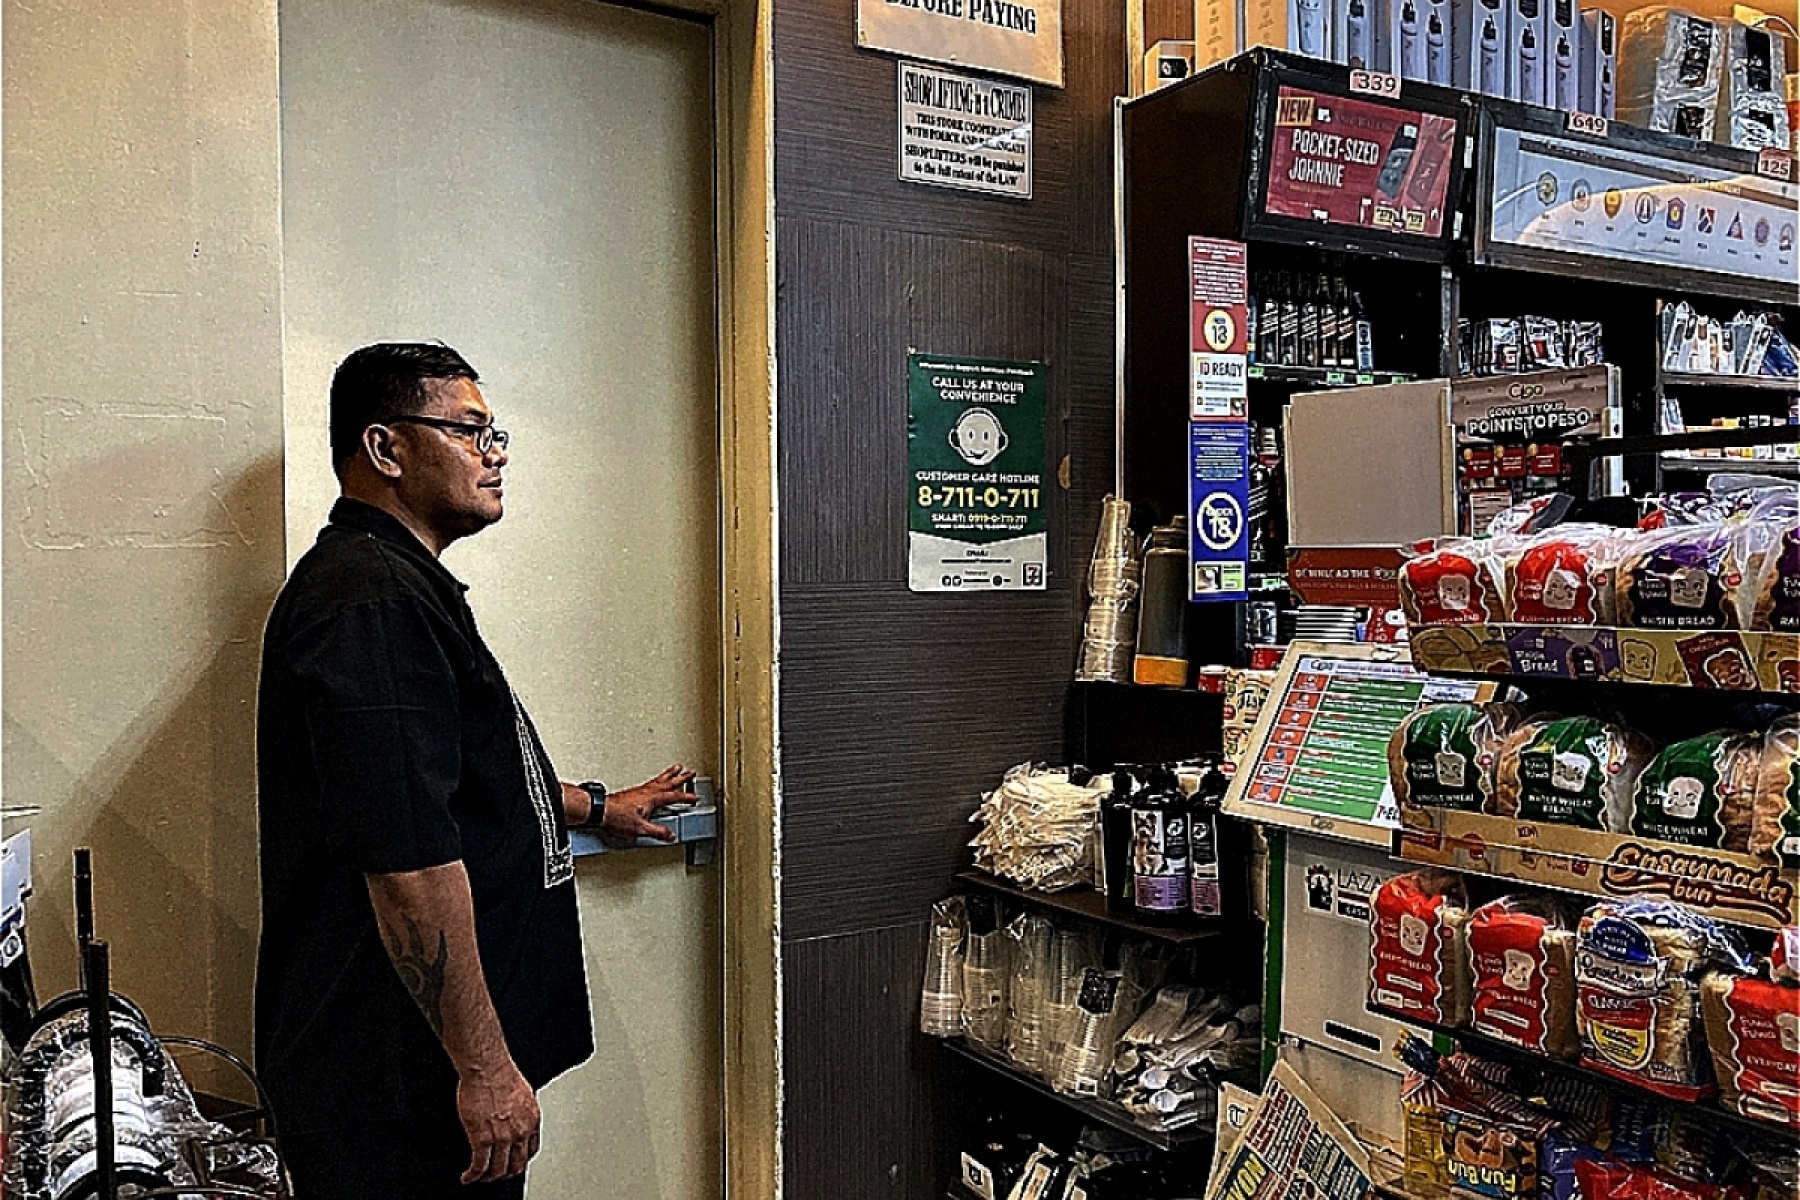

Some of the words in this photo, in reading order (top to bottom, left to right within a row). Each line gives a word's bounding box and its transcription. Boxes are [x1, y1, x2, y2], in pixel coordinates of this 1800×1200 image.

[969, 0, 1035, 34] PAYING
[905, 71, 974, 113] SHOPLIFTING
[1279, 98, 1311, 123] NEW
[1291, 128, 1380, 165] POCKET-SIZED
[1288, 156, 1345, 188] JOHNNIE
[932, 376, 961, 388] CALL
[963, 377, 979, 390] US
[980, 379, 994, 390] AT
[995, 380, 1024, 393] YOUR
[940, 389, 1017, 404] CONVENIENCE
[1469, 416, 1523, 434] POINTS
[1523, 414, 1546, 430] TO
[1548, 410, 1589, 429] PESO
[915, 471, 971, 483] CUSTOMER
[972, 473, 997, 484] CARE
[1000, 474, 1040, 485] HOTLINE
[918, 485, 1040, 508] 8-711-0-711
[1295, 569, 1349, 579] DOWNLOAD
[1351, 569, 1370, 579] THE
[1678, 616, 1716, 625] BREAD
[1608, 847, 1788, 904] Ensaymada
[1673, 877, 1714, 903] bun
